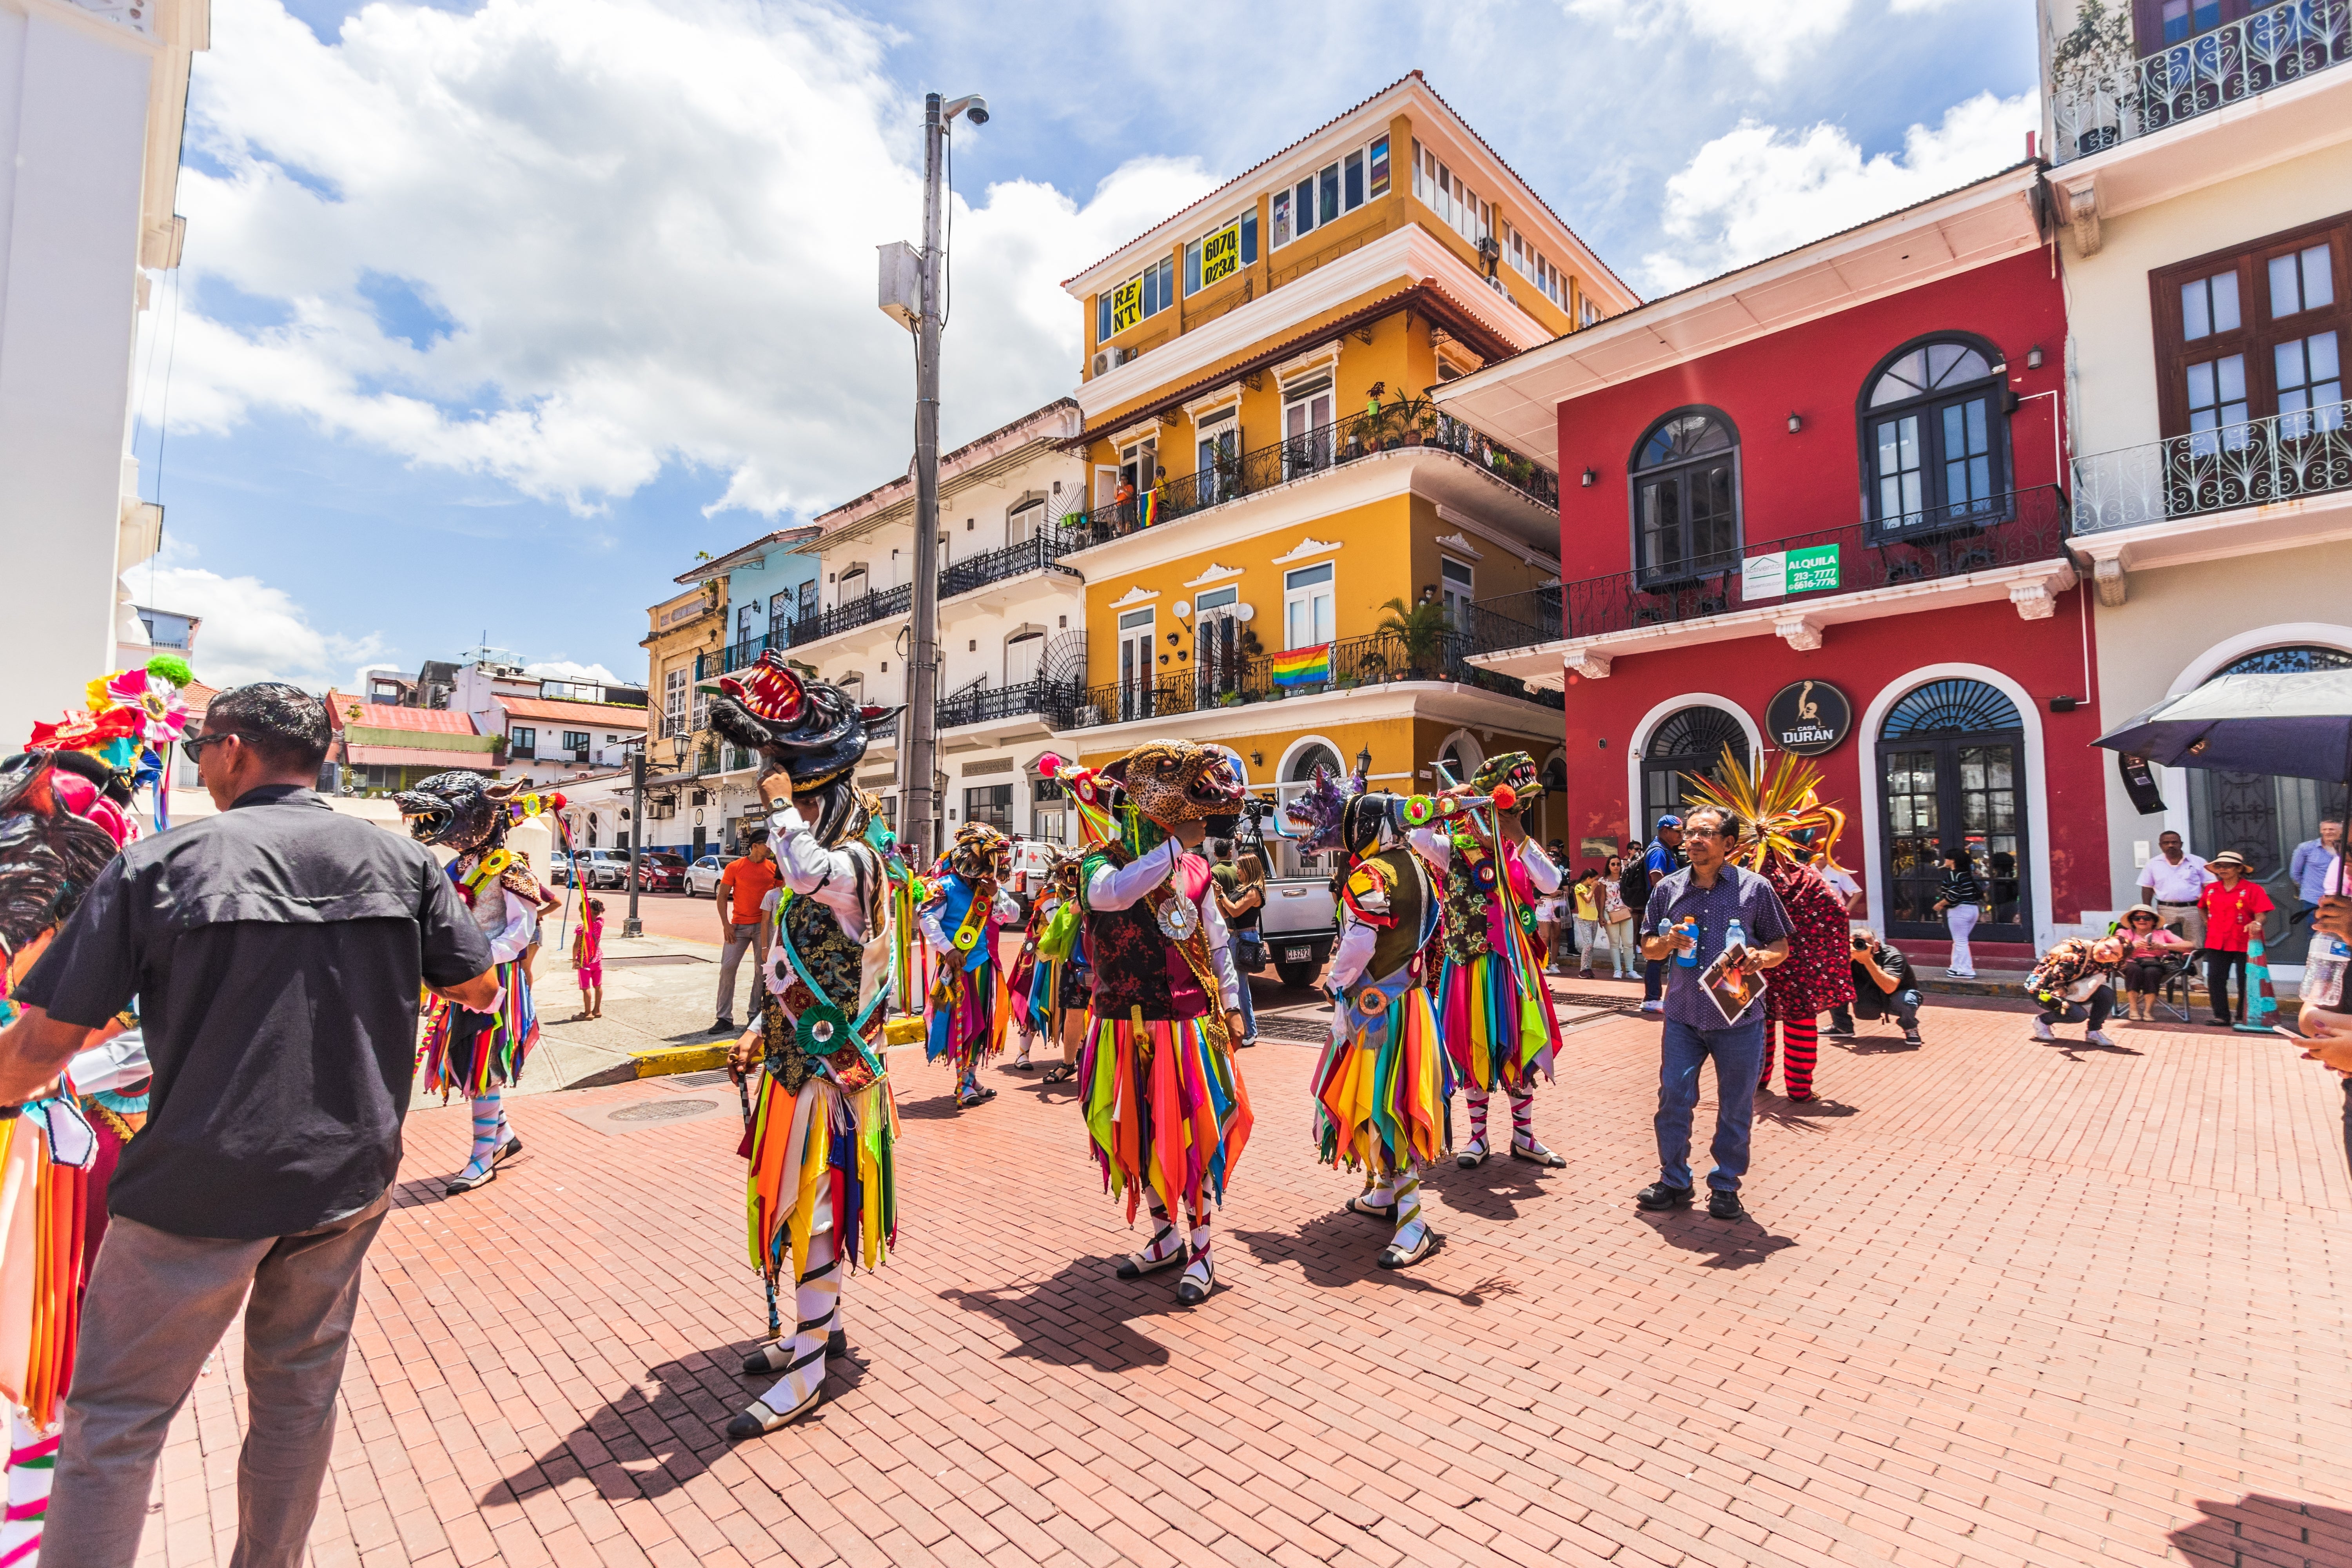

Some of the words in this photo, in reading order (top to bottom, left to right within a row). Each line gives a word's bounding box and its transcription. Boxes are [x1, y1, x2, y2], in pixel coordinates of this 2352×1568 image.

[1205, 230, 1235, 261] 6070
[1205, 258, 1236, 285] 0234
[1114, 283, 1136, 309] RE
[1114, 302, 1136, 332] NT
[1744, 563, 1784, 574] Activentas
[1788, 555, 1836, 570] ALQUILA
[1794, 568, 1836, 581] 213-7777
[1794, 577, 1837, 590] 6616-7776
[1782, 730, 1834, 743] DURÁN
[1288, 949, 1308, 958] CI3292
